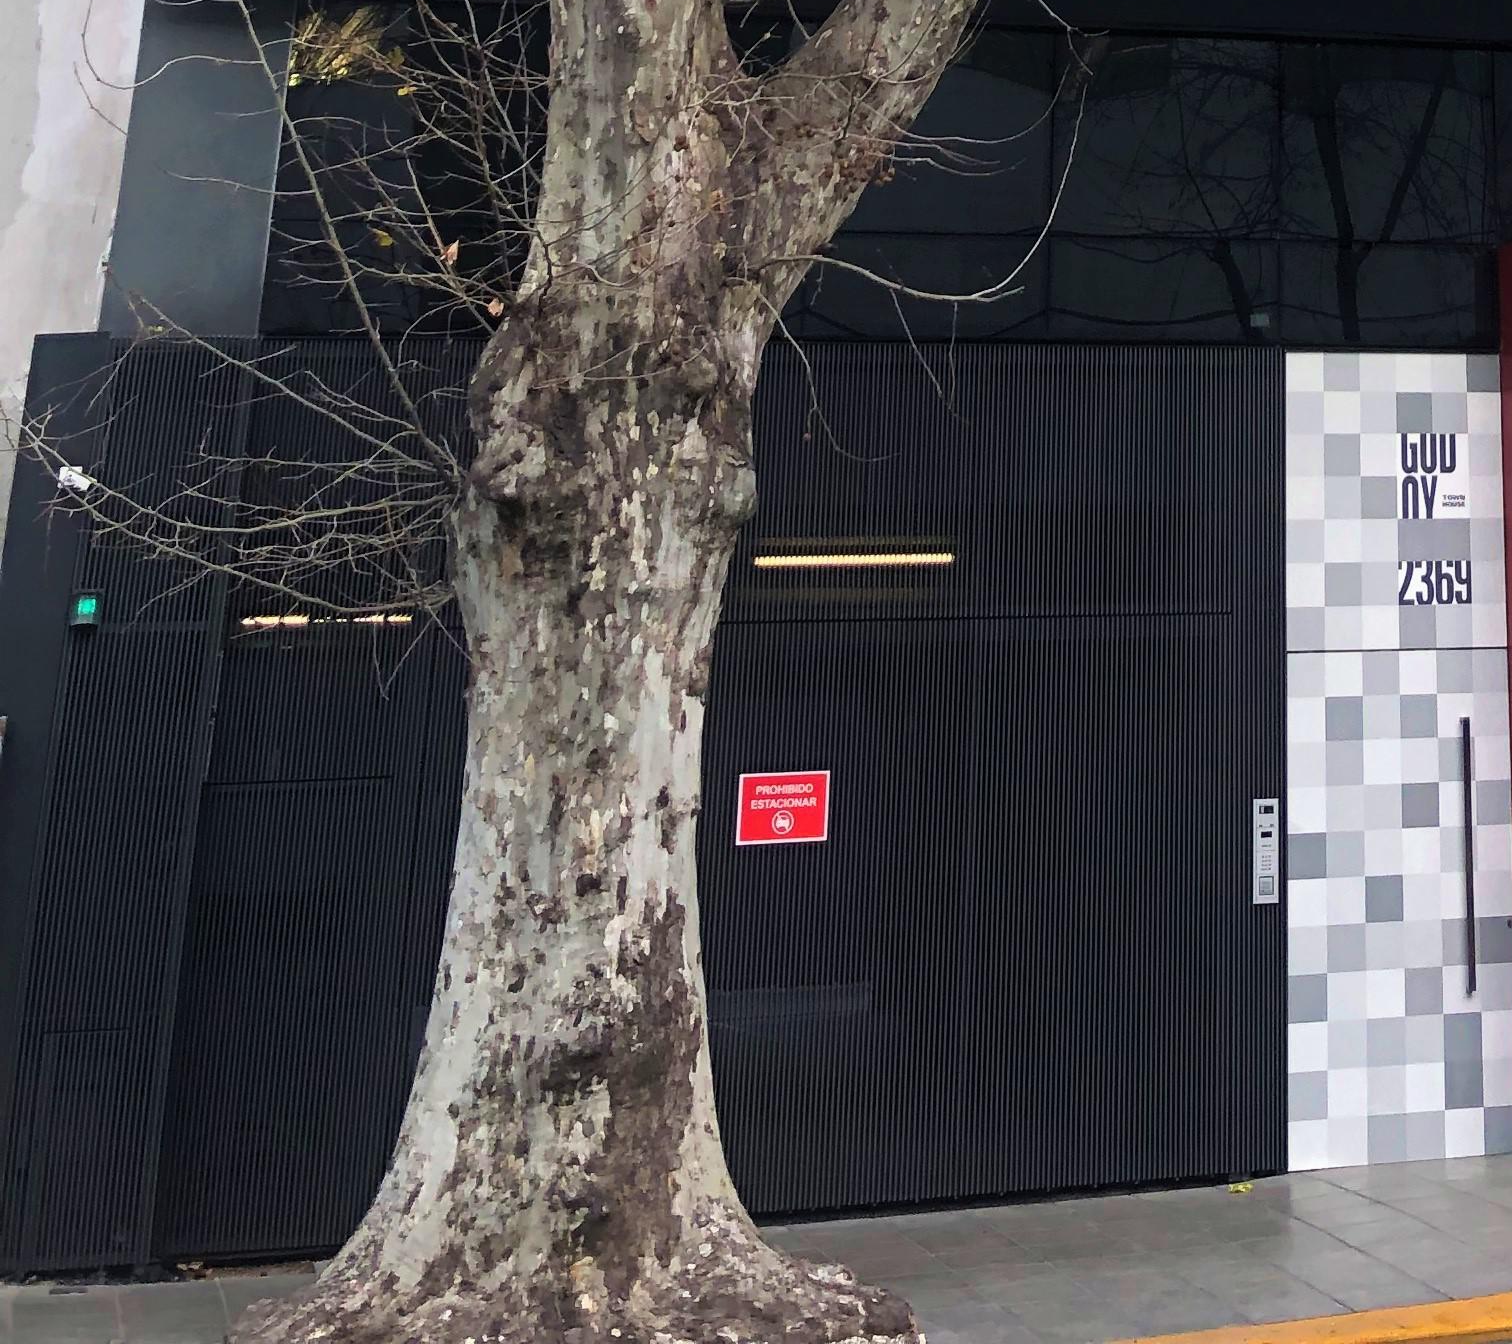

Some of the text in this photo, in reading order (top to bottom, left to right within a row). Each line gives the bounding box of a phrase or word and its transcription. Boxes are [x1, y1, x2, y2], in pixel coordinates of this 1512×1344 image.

[1398, 560, 1472, 605] 2369
[755, 783, 813, 795] PROHIBIDO
[750, 797, 817, 809] ESTACIONAR
